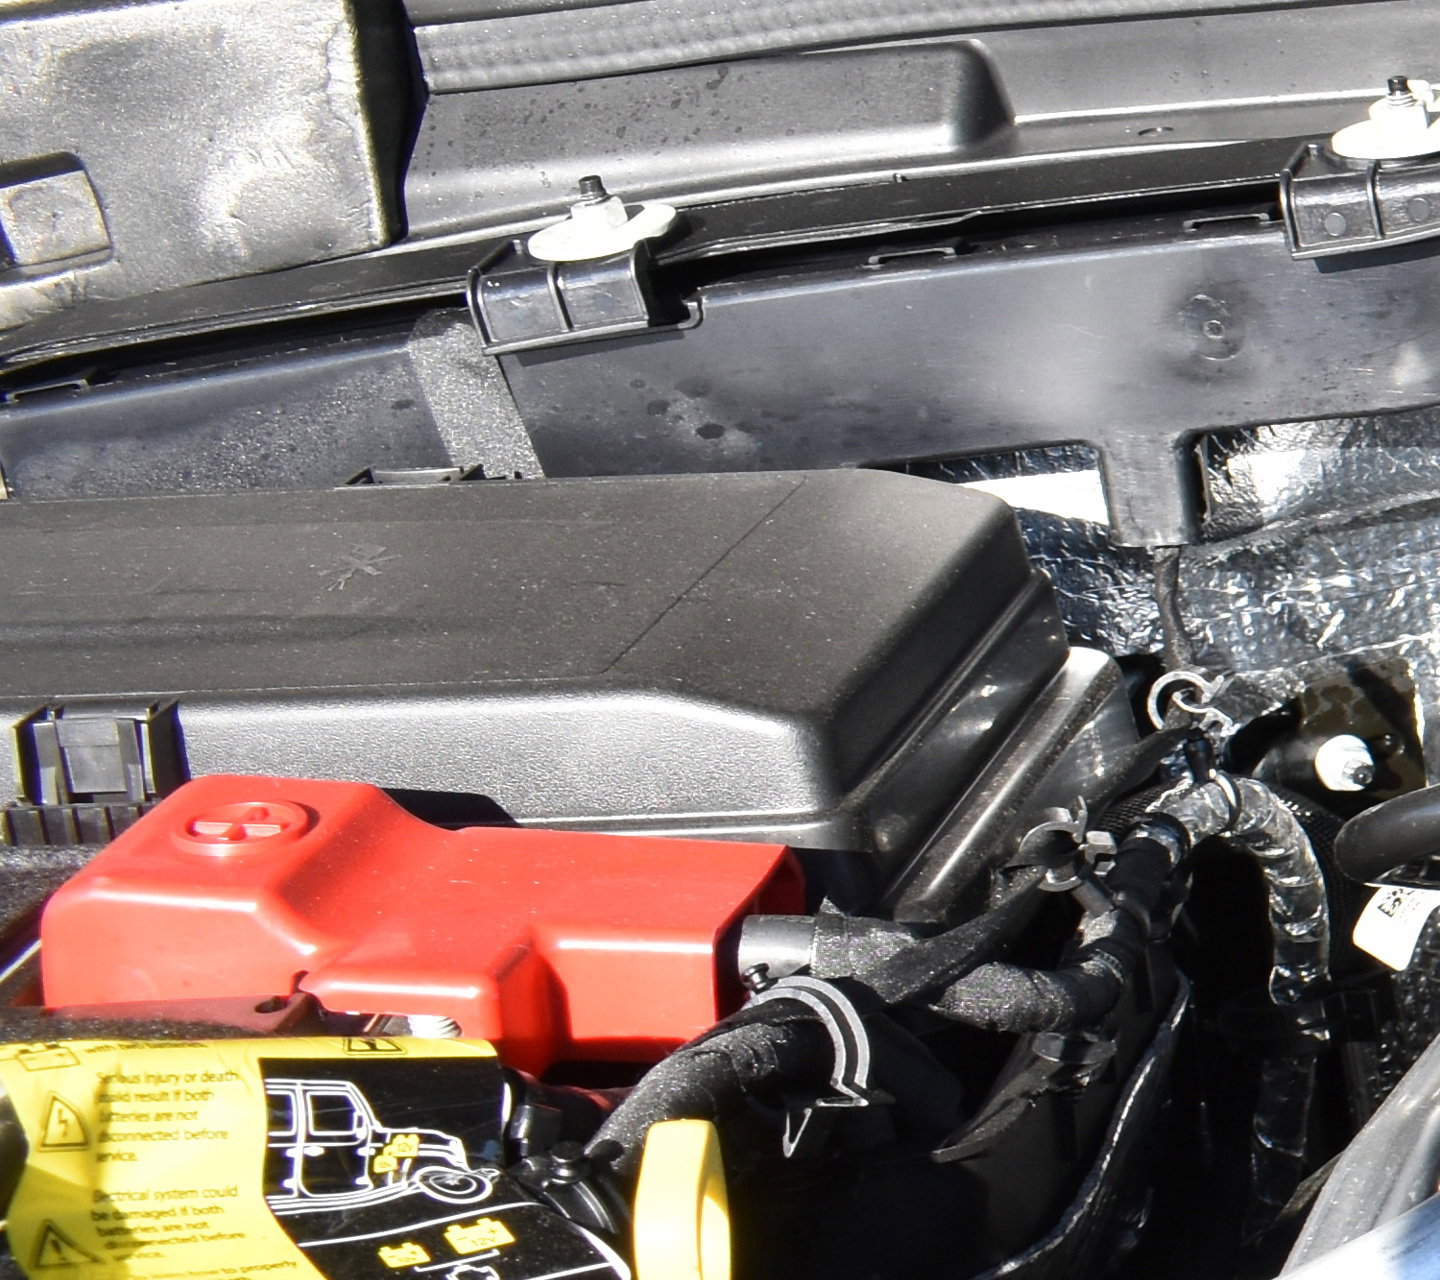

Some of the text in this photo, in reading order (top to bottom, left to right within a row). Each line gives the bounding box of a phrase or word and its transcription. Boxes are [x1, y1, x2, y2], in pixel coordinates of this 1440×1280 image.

[144, 1072, 180, 1086] injury
[184, 1073, 197, 1083] or
[201, 1070, 238, 1083] death
[135, 1091, 169, 1102] result
[173, 1090, 181, 1101] if
[185, 1090, 214, 1102] both
[154, 1111, 172, 1122] are
[177, 1110, 199, 1121] not
[185, 1128, 229, 1140] before
[154, 1189, 198, 1203] system
[203, 1185, 238, 1199] could
[112, 1207, 176, 1221] damaged
[192, 1204, 225, 1216] both
[163, 1223, 182, 1233] are
[186, 1221, 209, 1231] not
